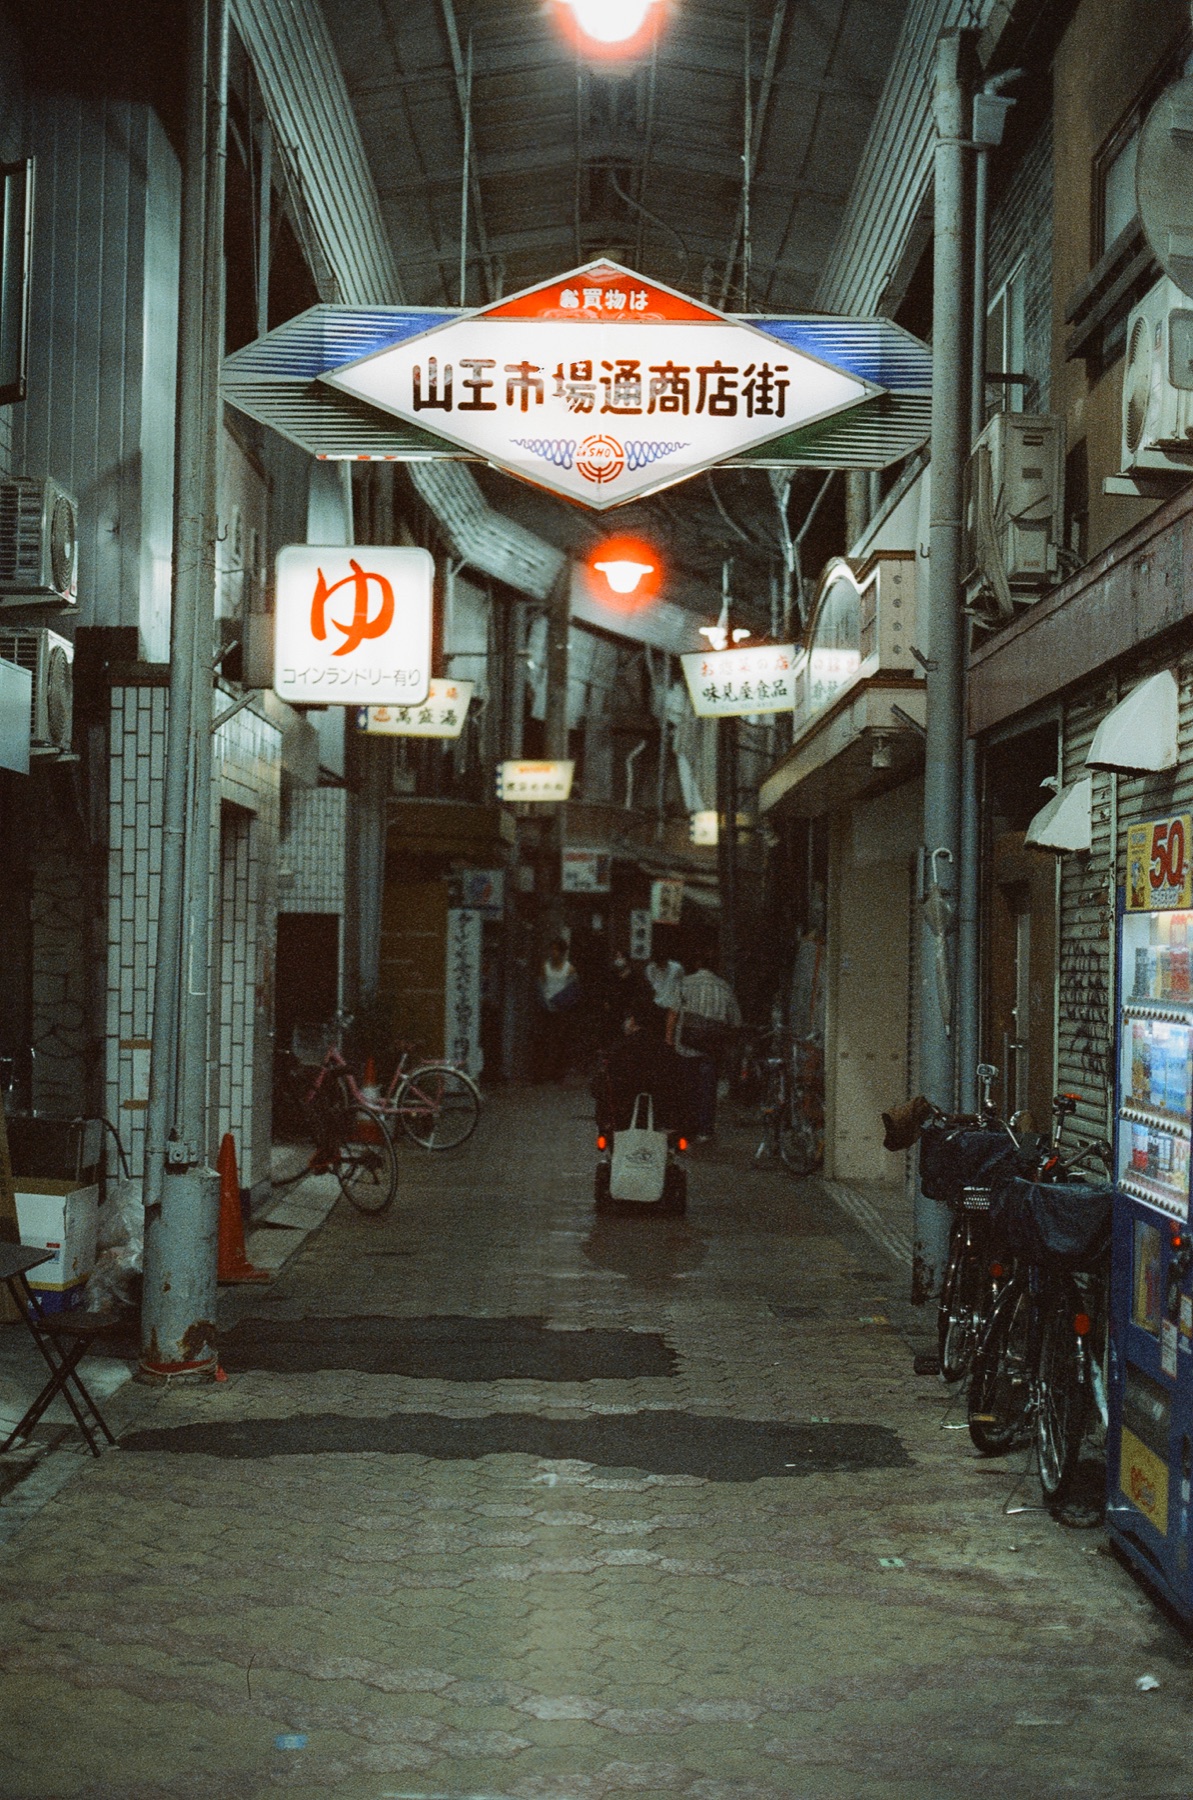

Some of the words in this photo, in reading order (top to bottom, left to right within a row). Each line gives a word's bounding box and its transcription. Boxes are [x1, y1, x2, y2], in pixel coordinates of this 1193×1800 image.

[412, 356, 791, 418] 山王市場通商店街
[309, 558, 396, 657] ゆ
[283, 667, 422, 687] コインランドリー有り
